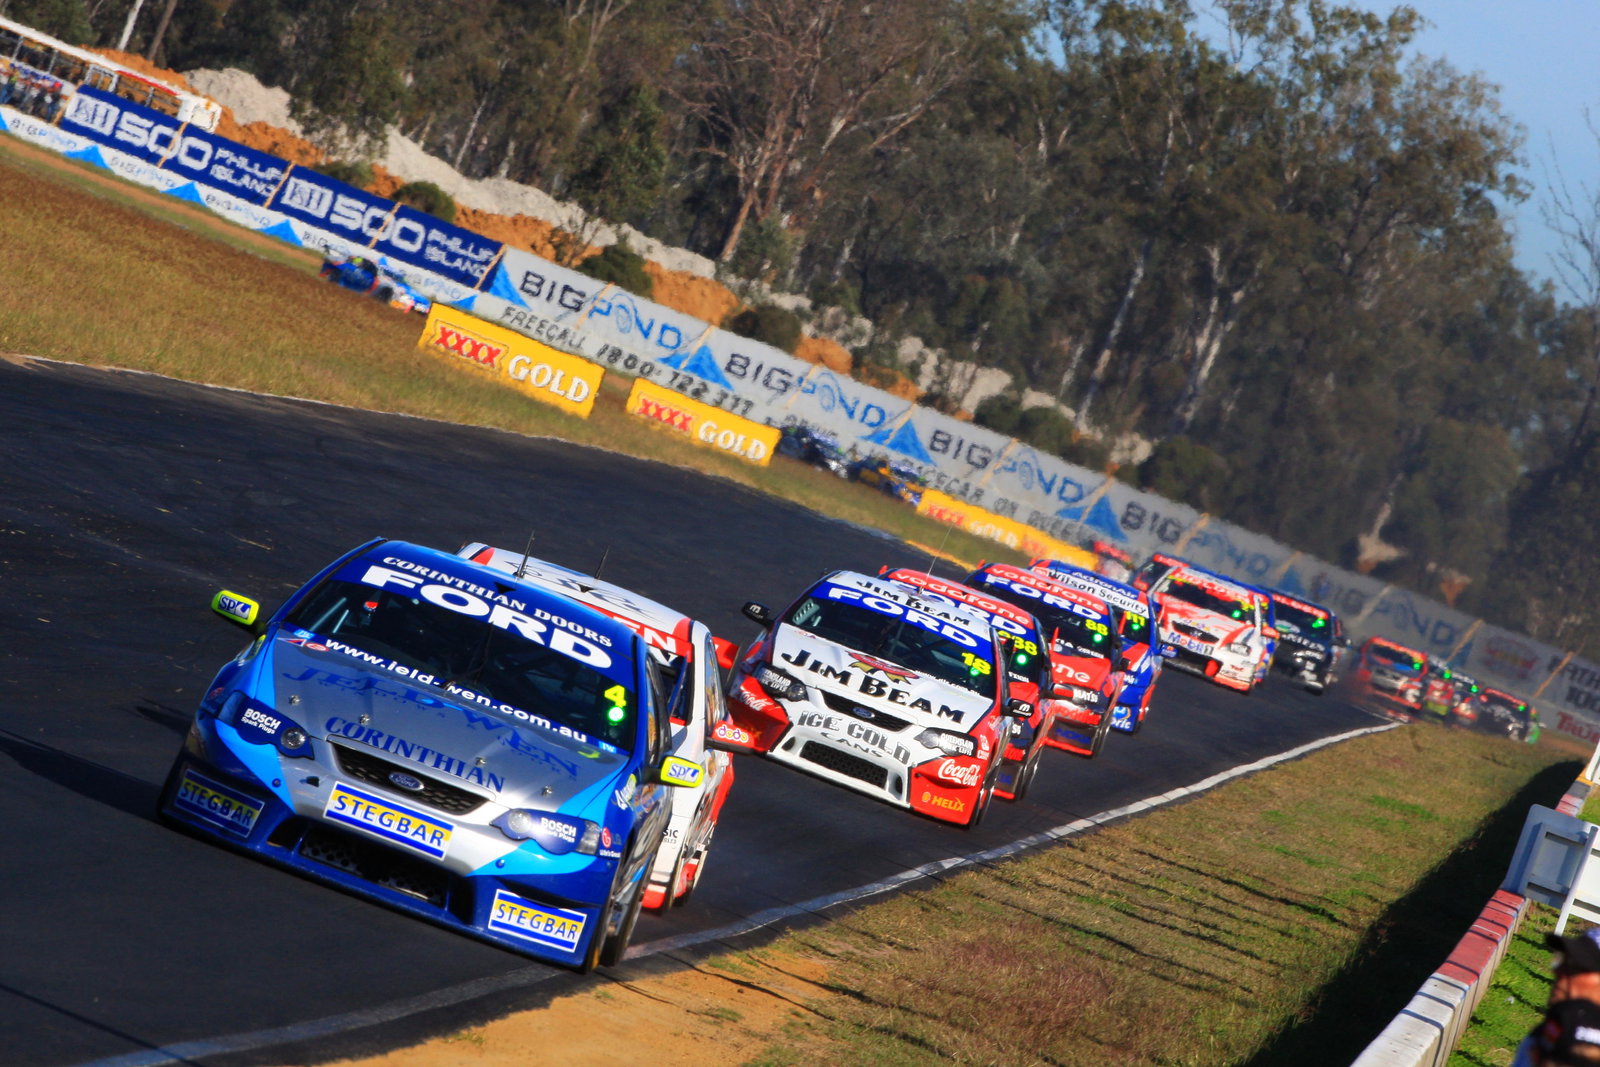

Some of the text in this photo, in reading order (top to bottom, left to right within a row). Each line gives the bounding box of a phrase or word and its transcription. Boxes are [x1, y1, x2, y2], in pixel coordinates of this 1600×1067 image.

[115, 111, 213, 171] 500
[329, 193, 425, 253] 500
[501, 305, 585, 350] FREECALL
[434, 325, 590, 403] XXXX GOLD
[637, 398, 693, 432] XXXX
[698, 420, 768, 461] GOLD
[968, 520, 1019, 549] GOLD
[382, 556, 613, 648] CORINTHIAN DOORS
[856, 579, 971, 627] JIM BEAM
[895, 573, 1030, 625] vodafone
[985, 573, 1102, 620] FORD
[991, 567, 1105, 612] vodafone
[1048, 570, 1147, 614] Wilson Security
[360, 564, 612, 669] FORD
[827, 587, 978, 648] FORD
[1085, 618, 1109, 636] 88
[961, 651, 992, 676] 18
[1168, 631, 1205, 653] Mobil
[604, 684, 627, 708] 4
[780, 649, 854, 687] JIM
[858, 674, 966, 724] BEAM
[243, 708, 282, 730] BOSCH
[258, 723, 276, 735] Plugs
[715, 725, 750, 744] dodo
[797, 710, 912, 765] ICE COLD
[324, 715, 506, 794] CORINTHIAN
[820, 731, 883, 759] CANS
[390, 772, 420, 788] Ford
[938, 758, 980, 787] Coca-Cola
[180, 780, 259, 830] STEGBAR
[335, 794, 446, 848] STEGBAR
[931, 794, 966, 813] HELIX
[541, 816, 577, 838] BOSCH
[495, 902, 579, 941] STEGBAR
